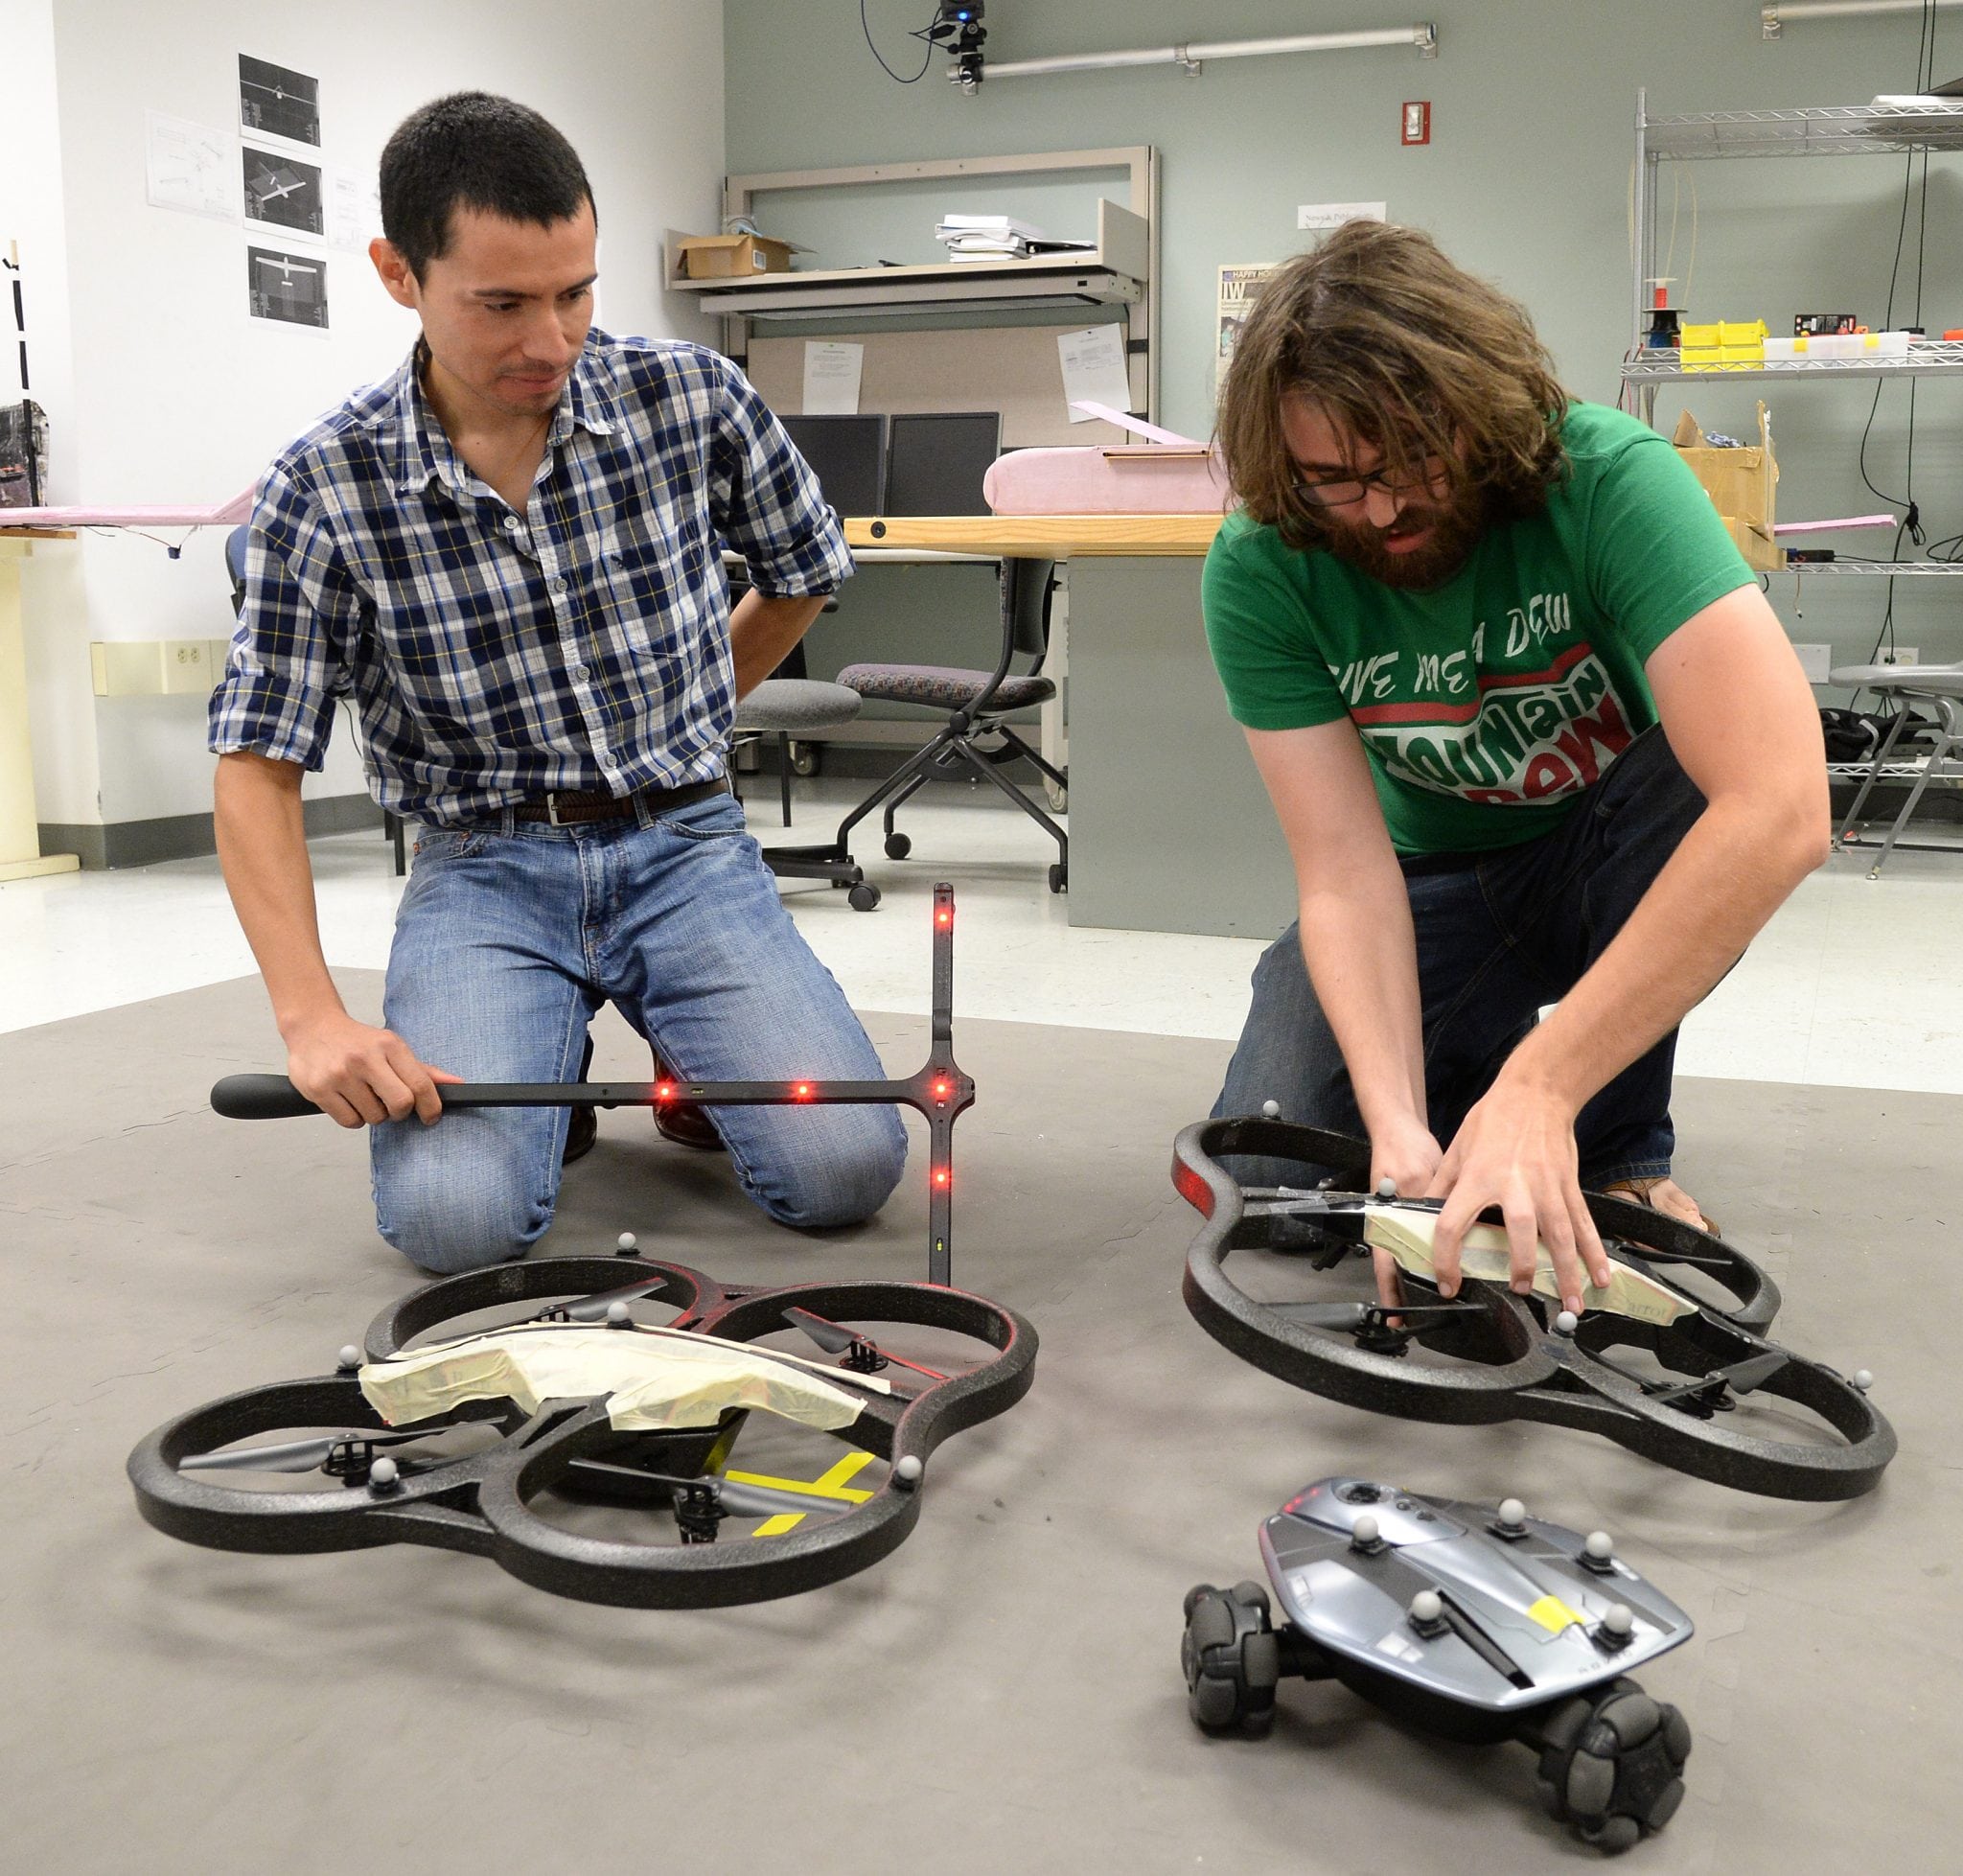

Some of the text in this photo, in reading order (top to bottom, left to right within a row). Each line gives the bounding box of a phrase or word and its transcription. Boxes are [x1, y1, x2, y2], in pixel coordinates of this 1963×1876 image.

[1233, 269, 1257, 279] HAPPY
[1328, 651, 1398, 706] IVE
[1414, 650, 1469, 694] ME
[1504, 592, 1571, 659] DEW
